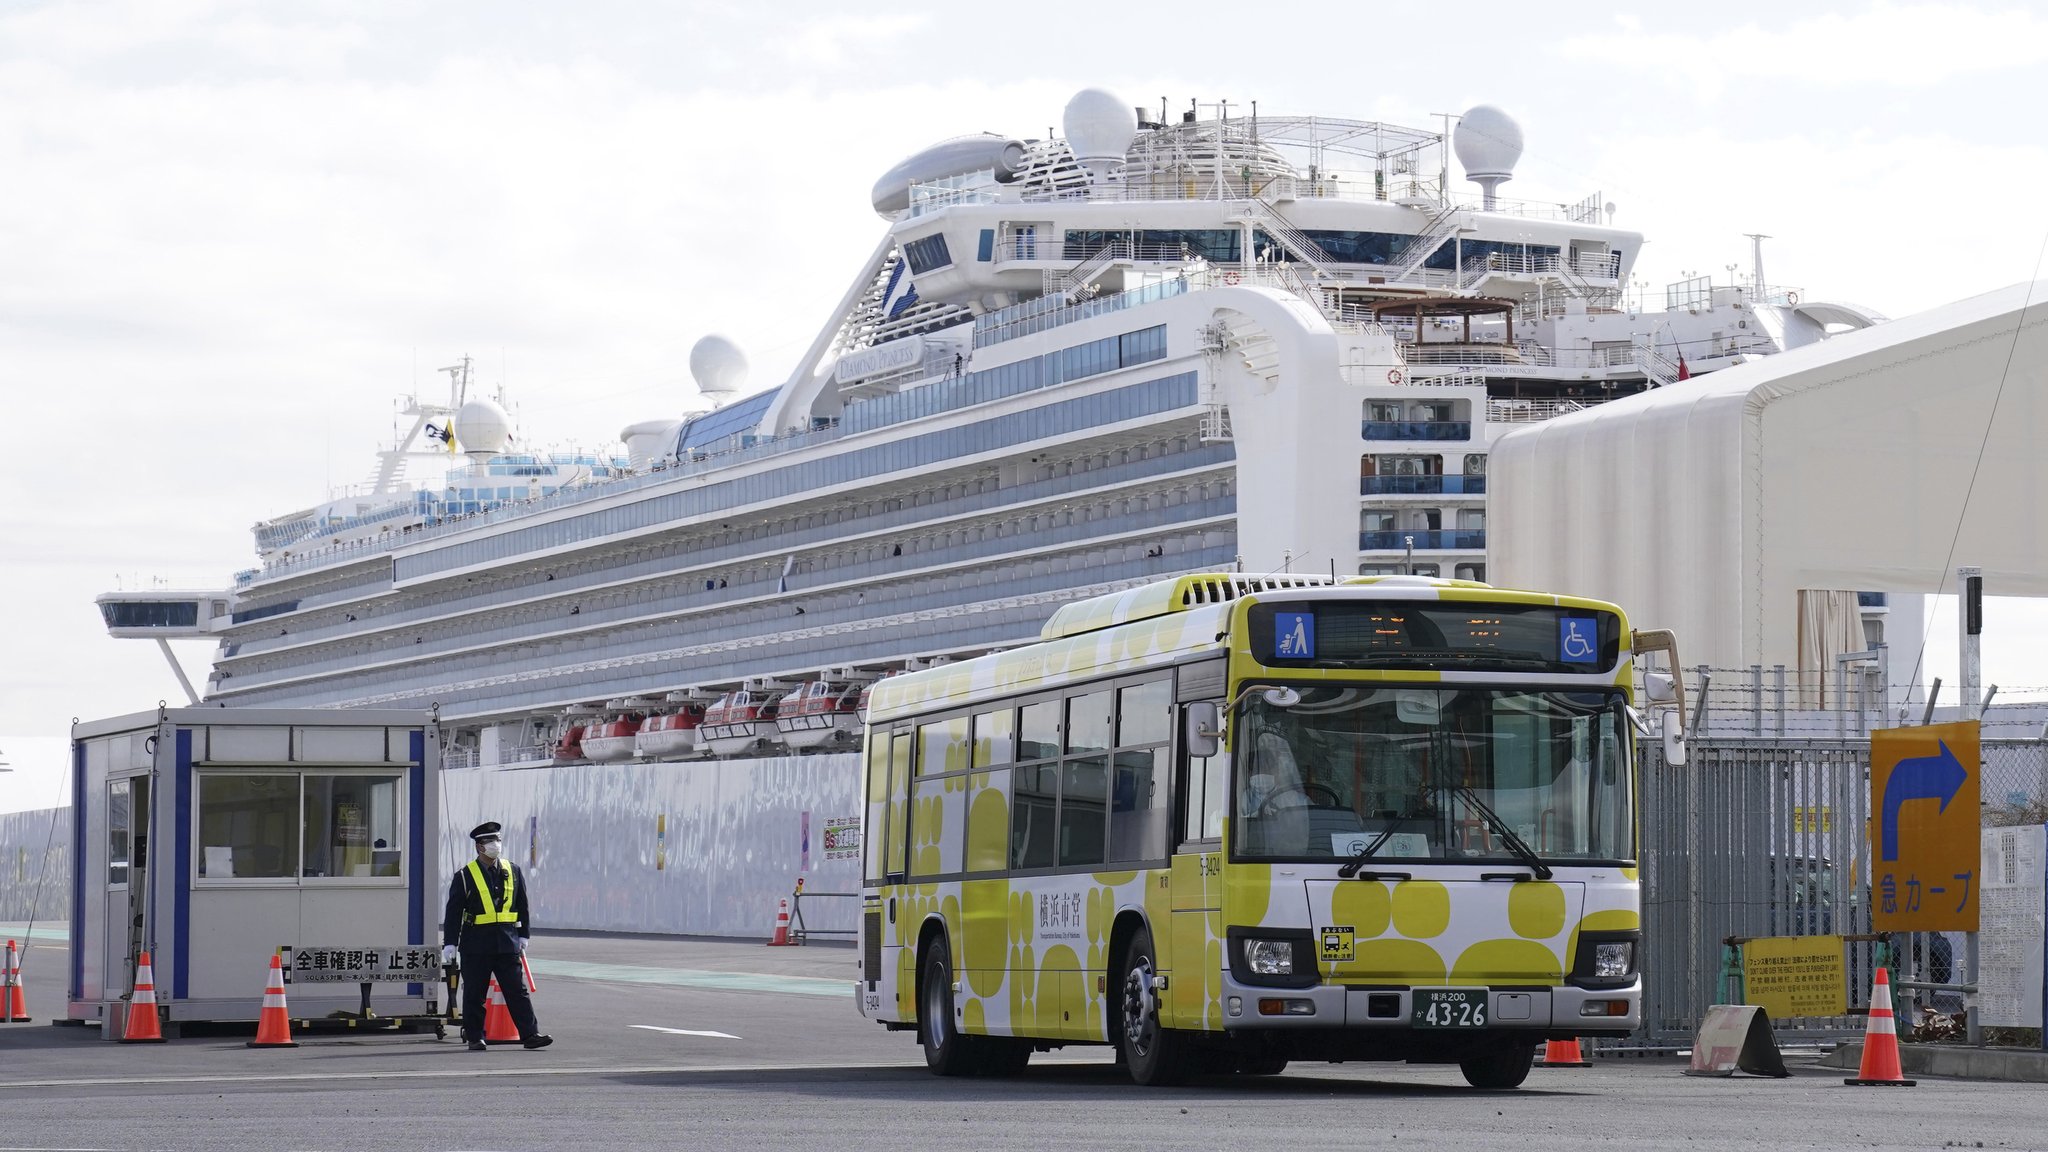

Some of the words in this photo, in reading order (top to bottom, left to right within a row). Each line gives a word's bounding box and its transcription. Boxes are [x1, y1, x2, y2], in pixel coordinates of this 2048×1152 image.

[841, 356, 876, 379] DIAMOND
[1880, 869, 1973, 914] 急カーブ
[1040, 892, 1080, 928] 横浜市営
[296, 950, 378, 970] 全車確認中
[388, 950, 438, 970] 止まれ
[1426, 1002, 1485, 1026] 43-26
